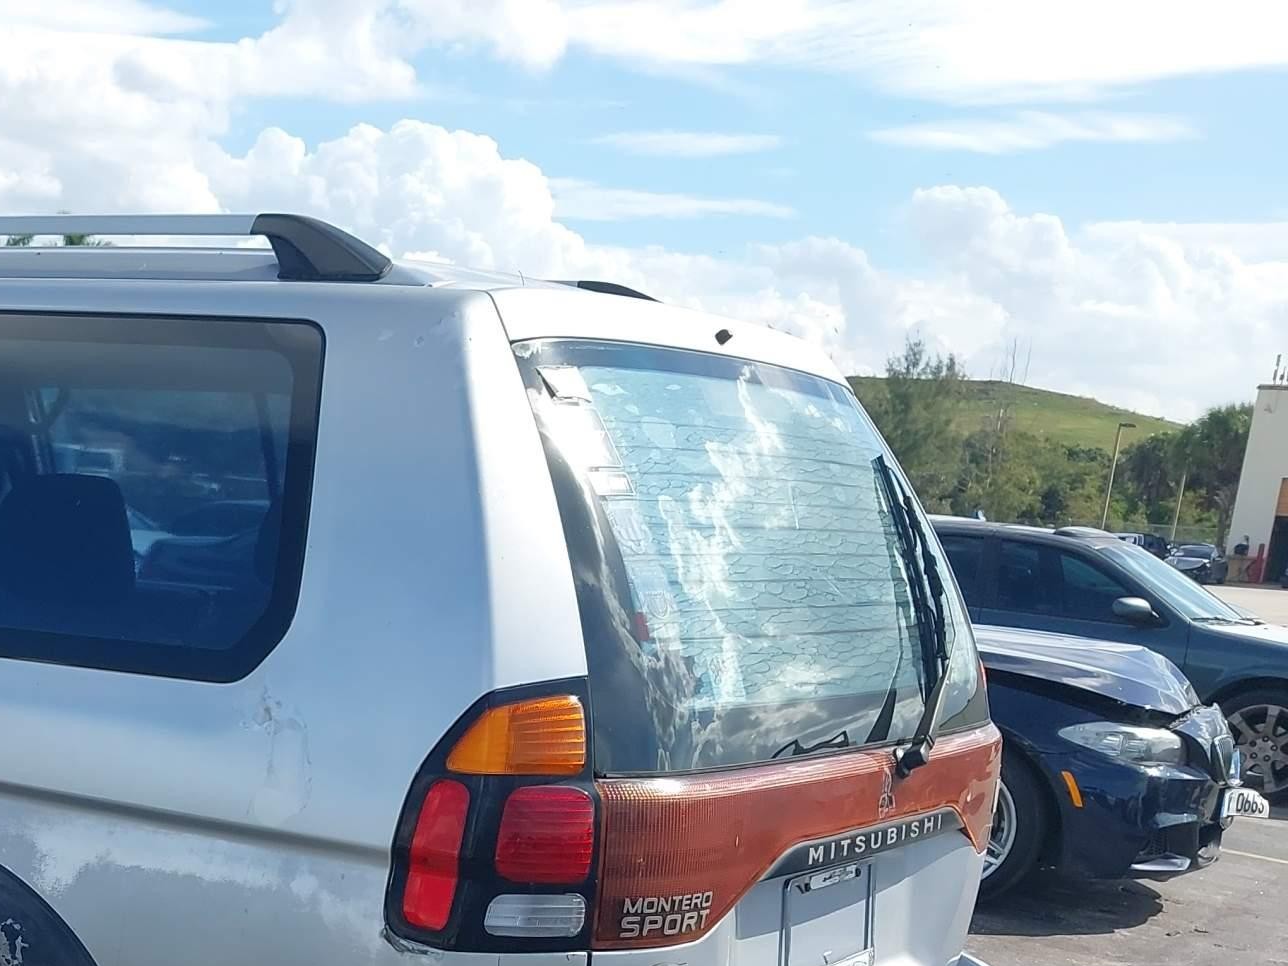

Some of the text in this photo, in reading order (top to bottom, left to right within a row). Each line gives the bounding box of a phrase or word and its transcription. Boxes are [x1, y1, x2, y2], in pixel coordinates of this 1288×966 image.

[808, 814, 943, 865] MITSUBISHI
[623, 891, 713, 914] MONTERO
[620, 909, 710, 938] SPORT
